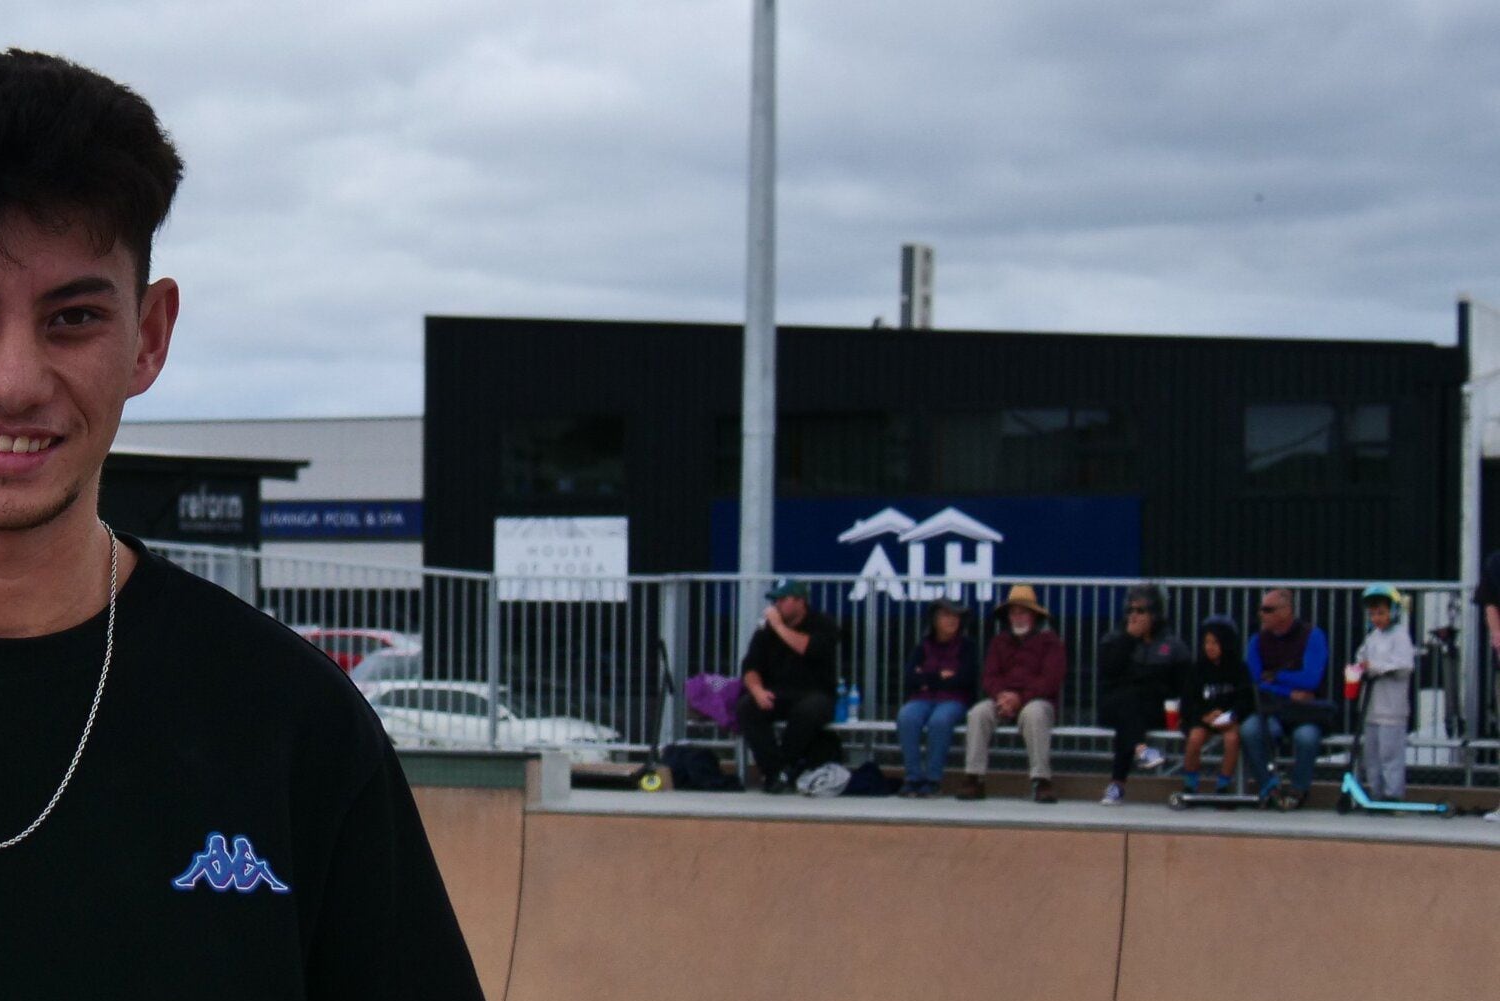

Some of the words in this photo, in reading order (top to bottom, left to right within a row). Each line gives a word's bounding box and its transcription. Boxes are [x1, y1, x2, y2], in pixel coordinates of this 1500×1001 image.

[323, 511, 360, 528] POOL
[365, 513, 376, 526] &
[379, 512, 404, 528] SPA
[526, 545, 594, 557] HOUSE
[553, 562, 605, 575] YOGA
[848, 542, 993, 602] ALH
